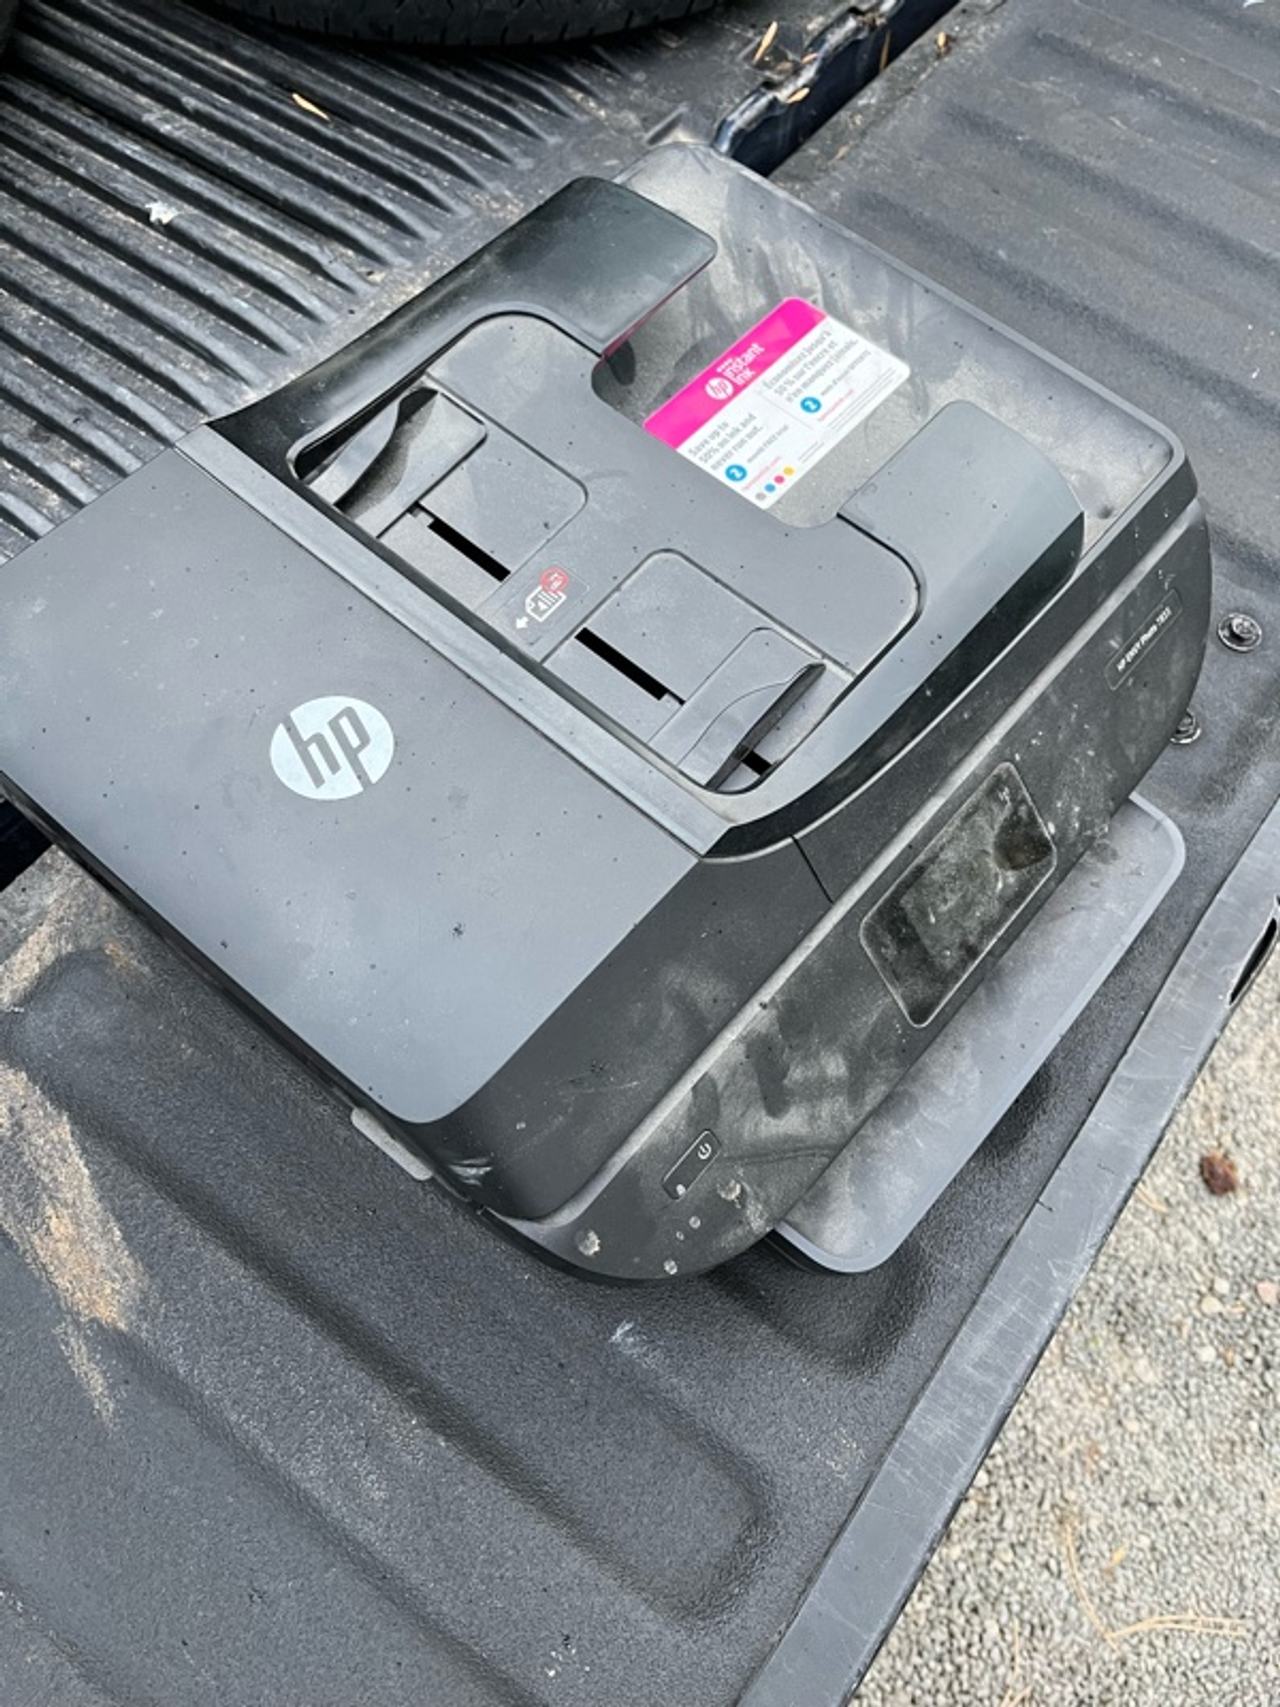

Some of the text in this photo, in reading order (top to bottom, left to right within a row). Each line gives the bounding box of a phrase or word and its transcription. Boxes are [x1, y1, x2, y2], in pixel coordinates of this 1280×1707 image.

[719, 343, 765, 378] instant
[731, 366, 756, 385] ink
[706, 378, 731, 398] hp
[687, 420, 729, 456] Save up to
[698, 412, 756, 464] 50% on ink and
[710, 423, 763, 471] never run out.
[280, 704, 373, 793] hp
